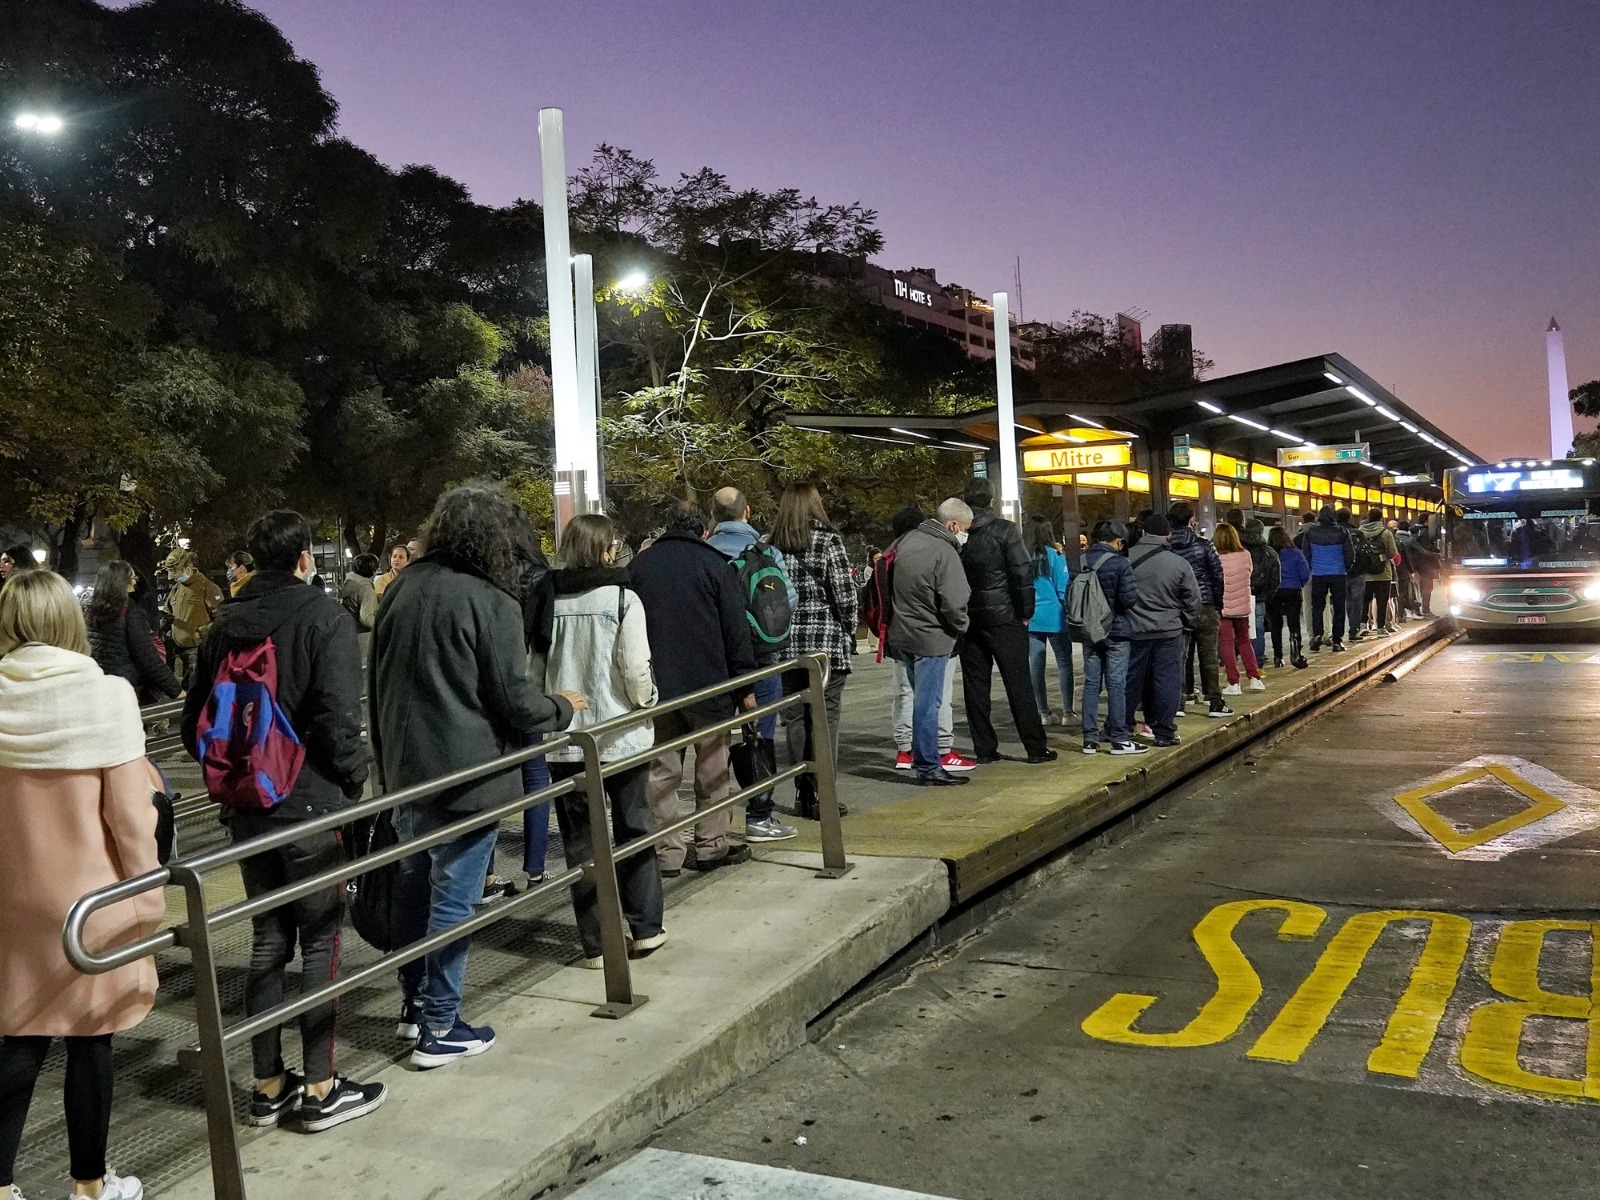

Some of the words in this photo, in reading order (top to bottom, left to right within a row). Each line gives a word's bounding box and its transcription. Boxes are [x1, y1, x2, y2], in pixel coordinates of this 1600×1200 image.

[1287, 453, 1299, 461] Sur
[1347, 450, 1357, 458] 10
[1050, 450, 1104, 468] Mitre
[1463, 511, 1518, 520] AVELLANEDA
[1081, 900, 1600, 1098] BUS
